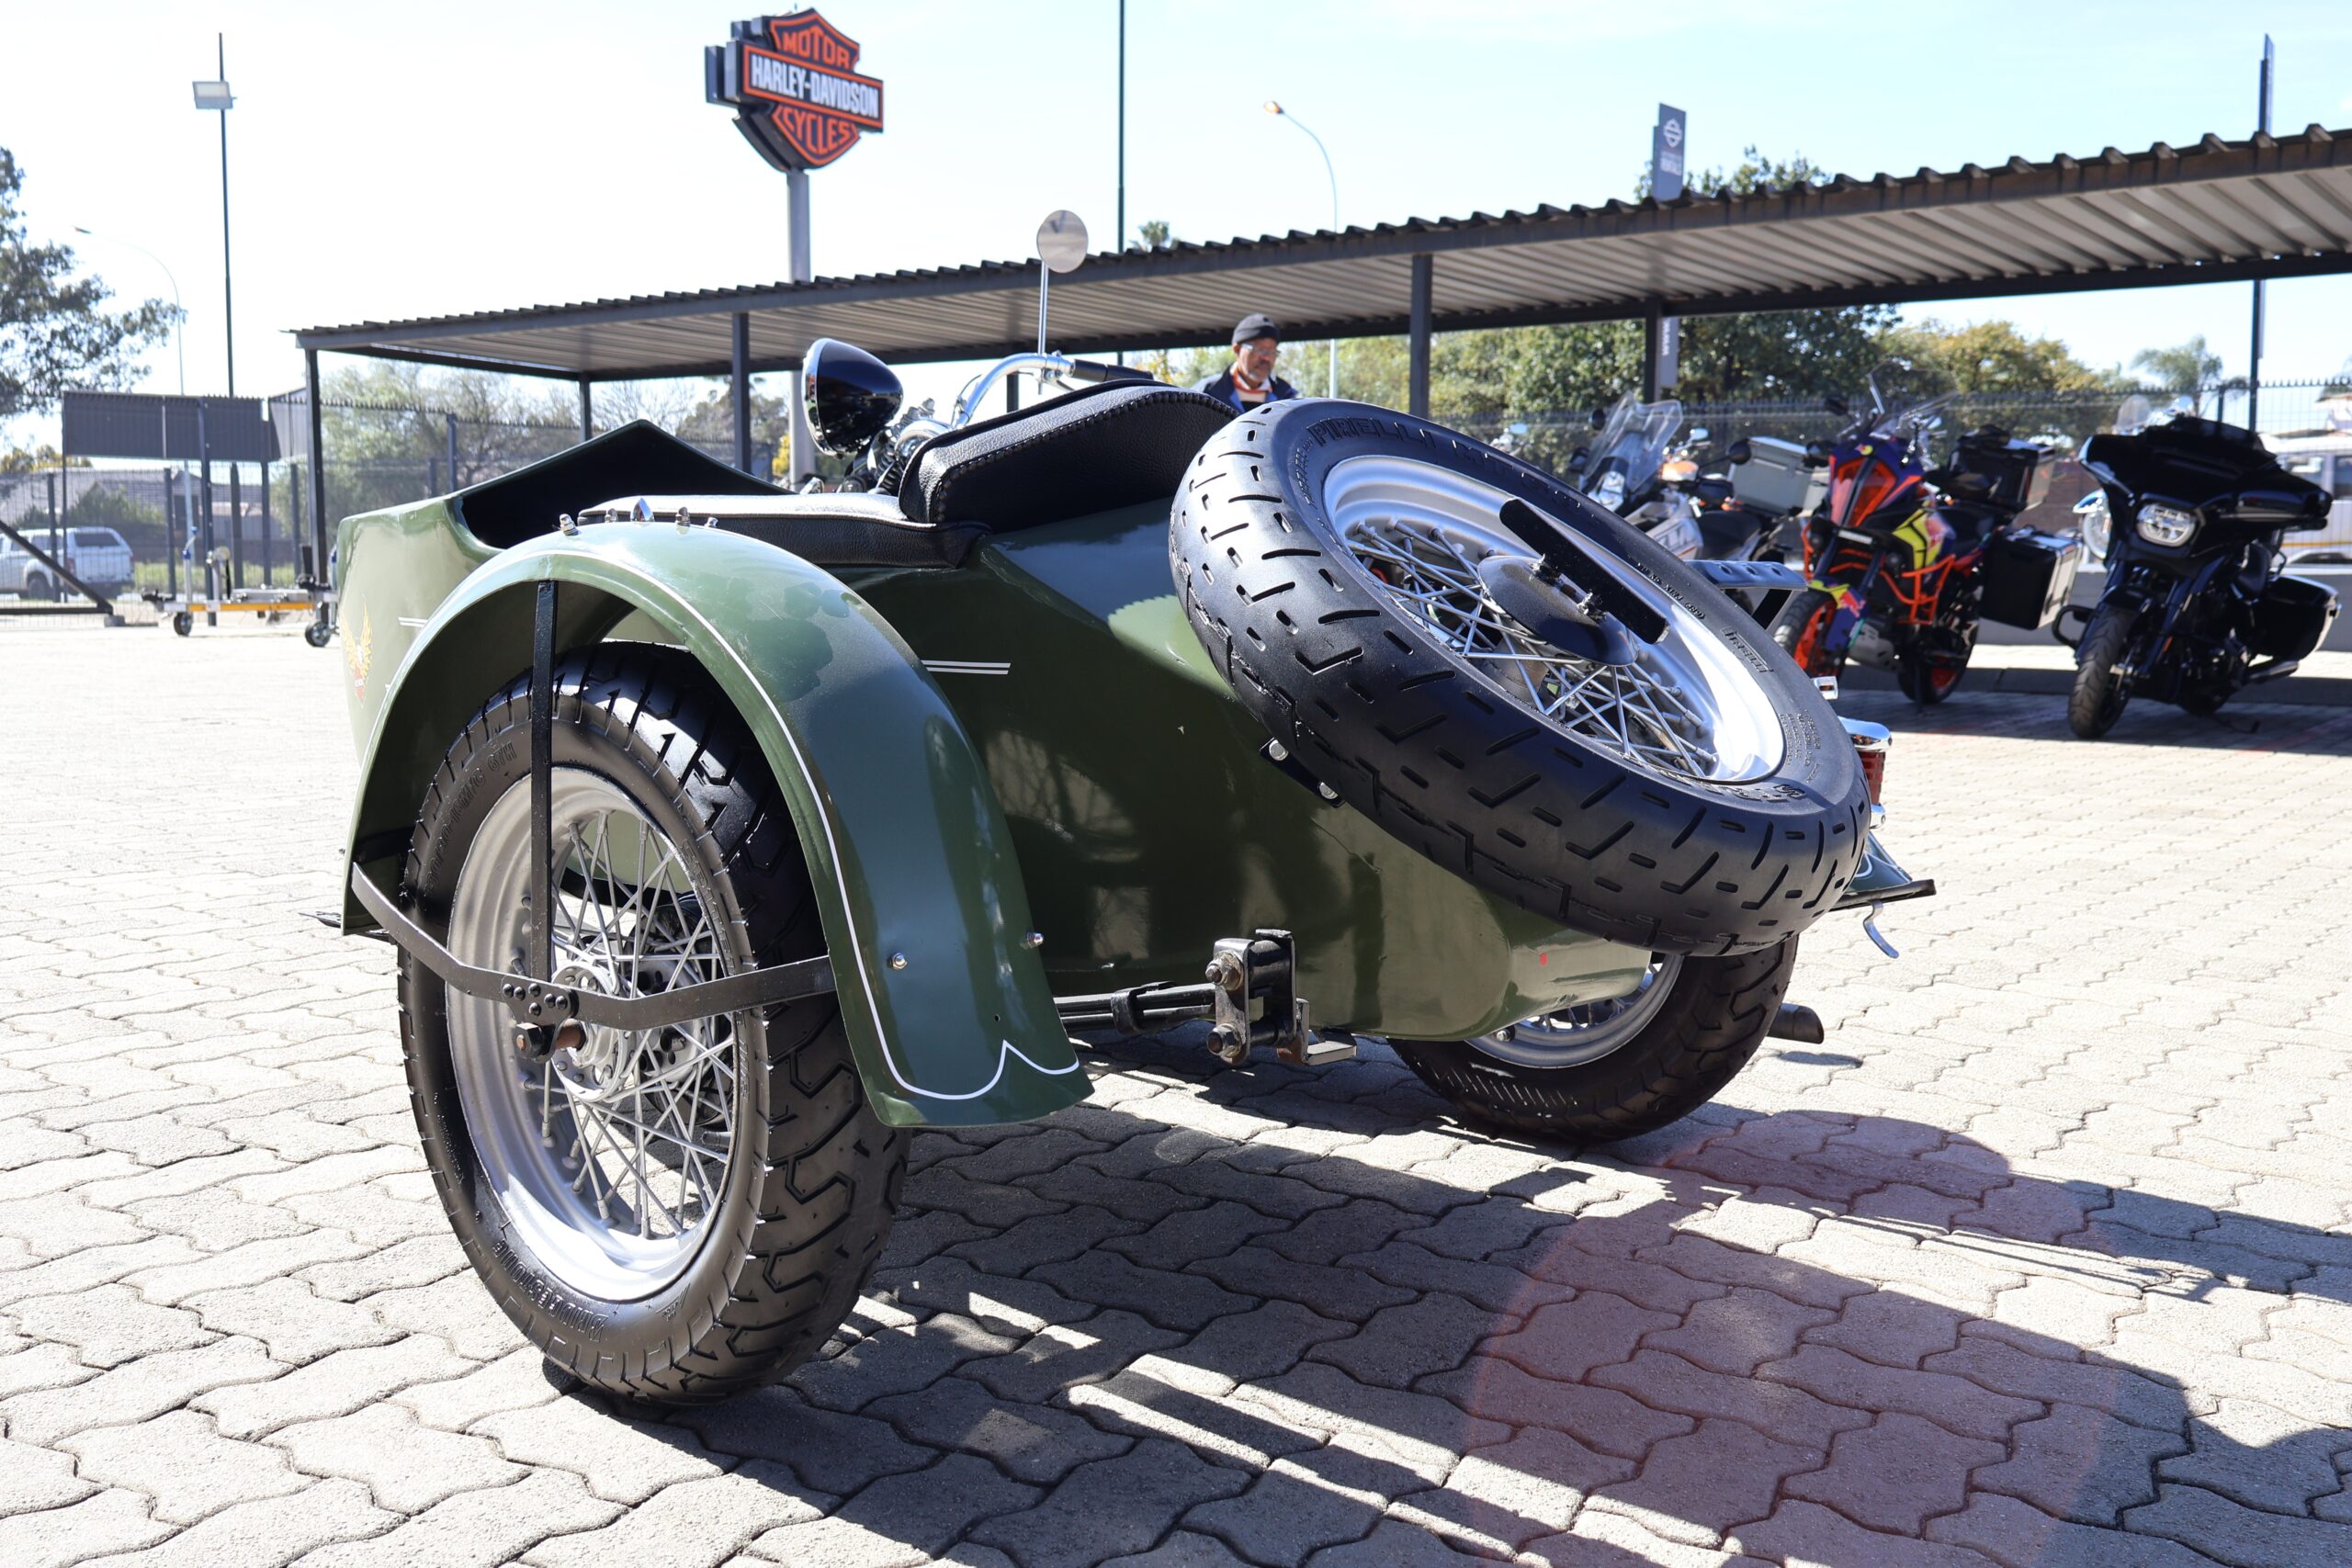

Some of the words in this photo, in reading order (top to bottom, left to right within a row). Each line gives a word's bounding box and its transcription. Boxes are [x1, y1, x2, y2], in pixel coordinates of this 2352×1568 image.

[782, 25, 851, 69] MOTOR
[751, 54, 879, 118] HARLEY-DAVIDSON
[782, 108, 851, 155] CYCLES
[1306, 417, 1436, 449] PIRELLI
[680, 838, 746, 1029] SPITFIE
[492, 1237, 609, 1343] BRIDGESTONE
